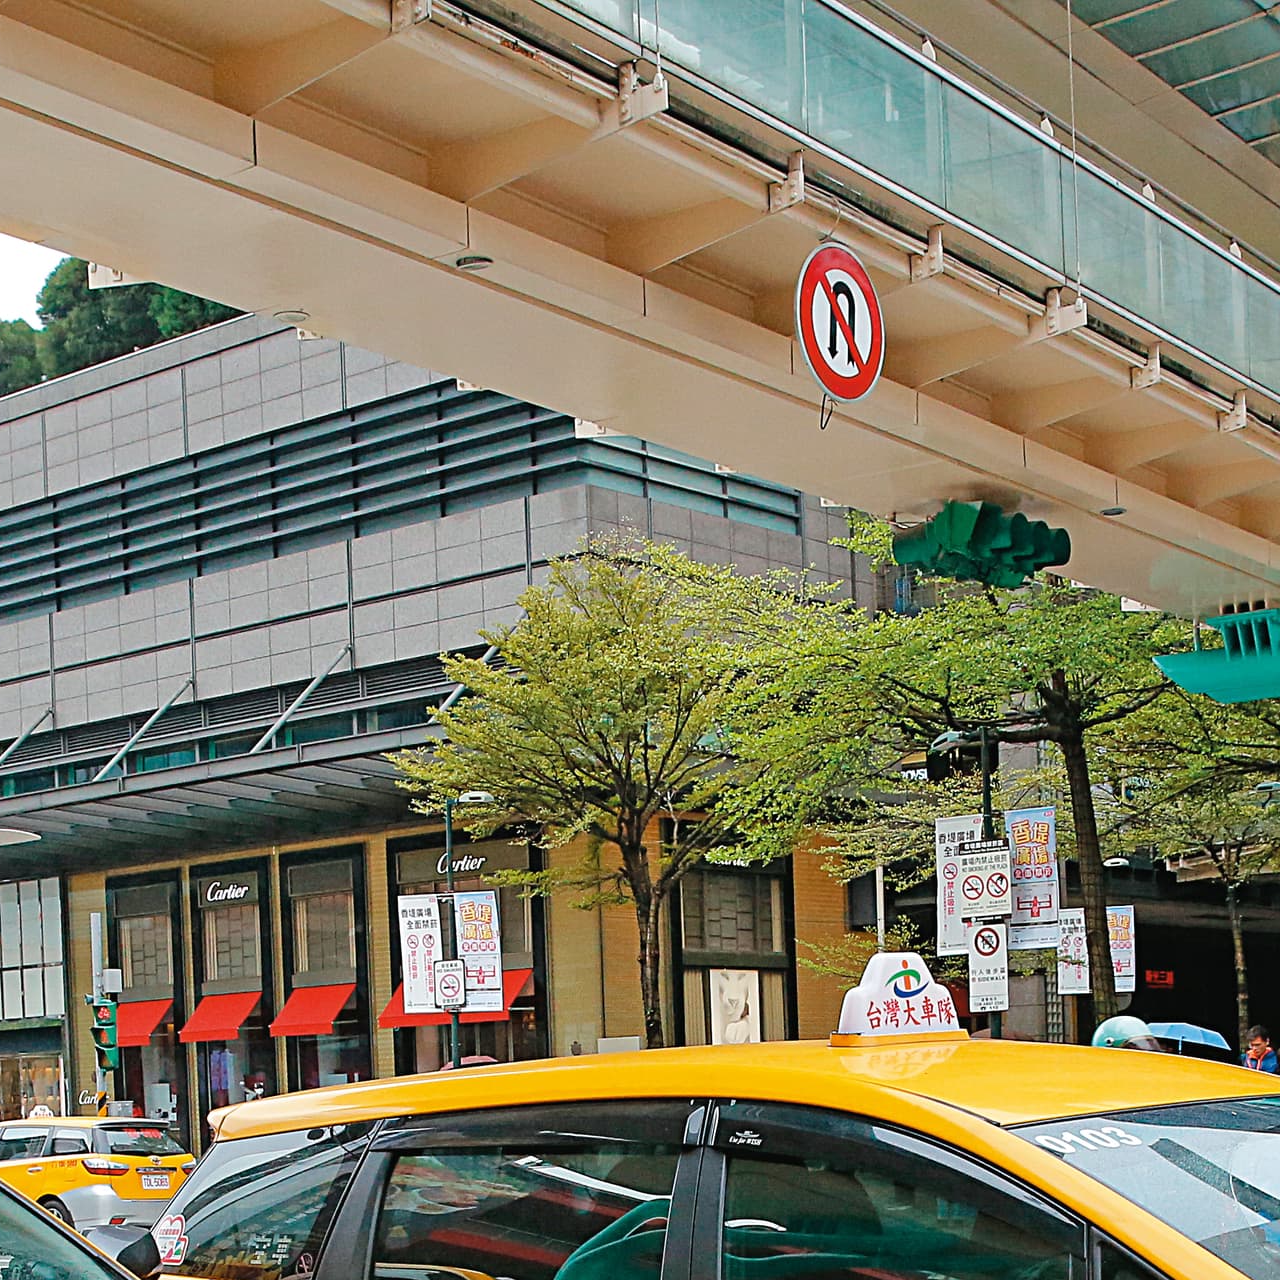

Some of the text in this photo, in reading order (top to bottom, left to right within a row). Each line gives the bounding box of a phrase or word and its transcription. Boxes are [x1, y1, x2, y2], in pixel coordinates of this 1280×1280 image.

[938, 829, 976, 845] 香堤廣場
[1011, 819, 1050, 846] 香堤
[1015, 845, 1050, 866] 廣場
[207, 881, 249, 902] Cartier
[401, 907, 432, 919] 香堤廣場
[460, 901, 493, 924] 香堤
[407, 919, 438, 930] 全面禁菸
[463, 923, 494, 941] 廣場
[866, 996, 956, 1029] 台灣大車隊
[1035, 1126, 1143, 1154] 0103
